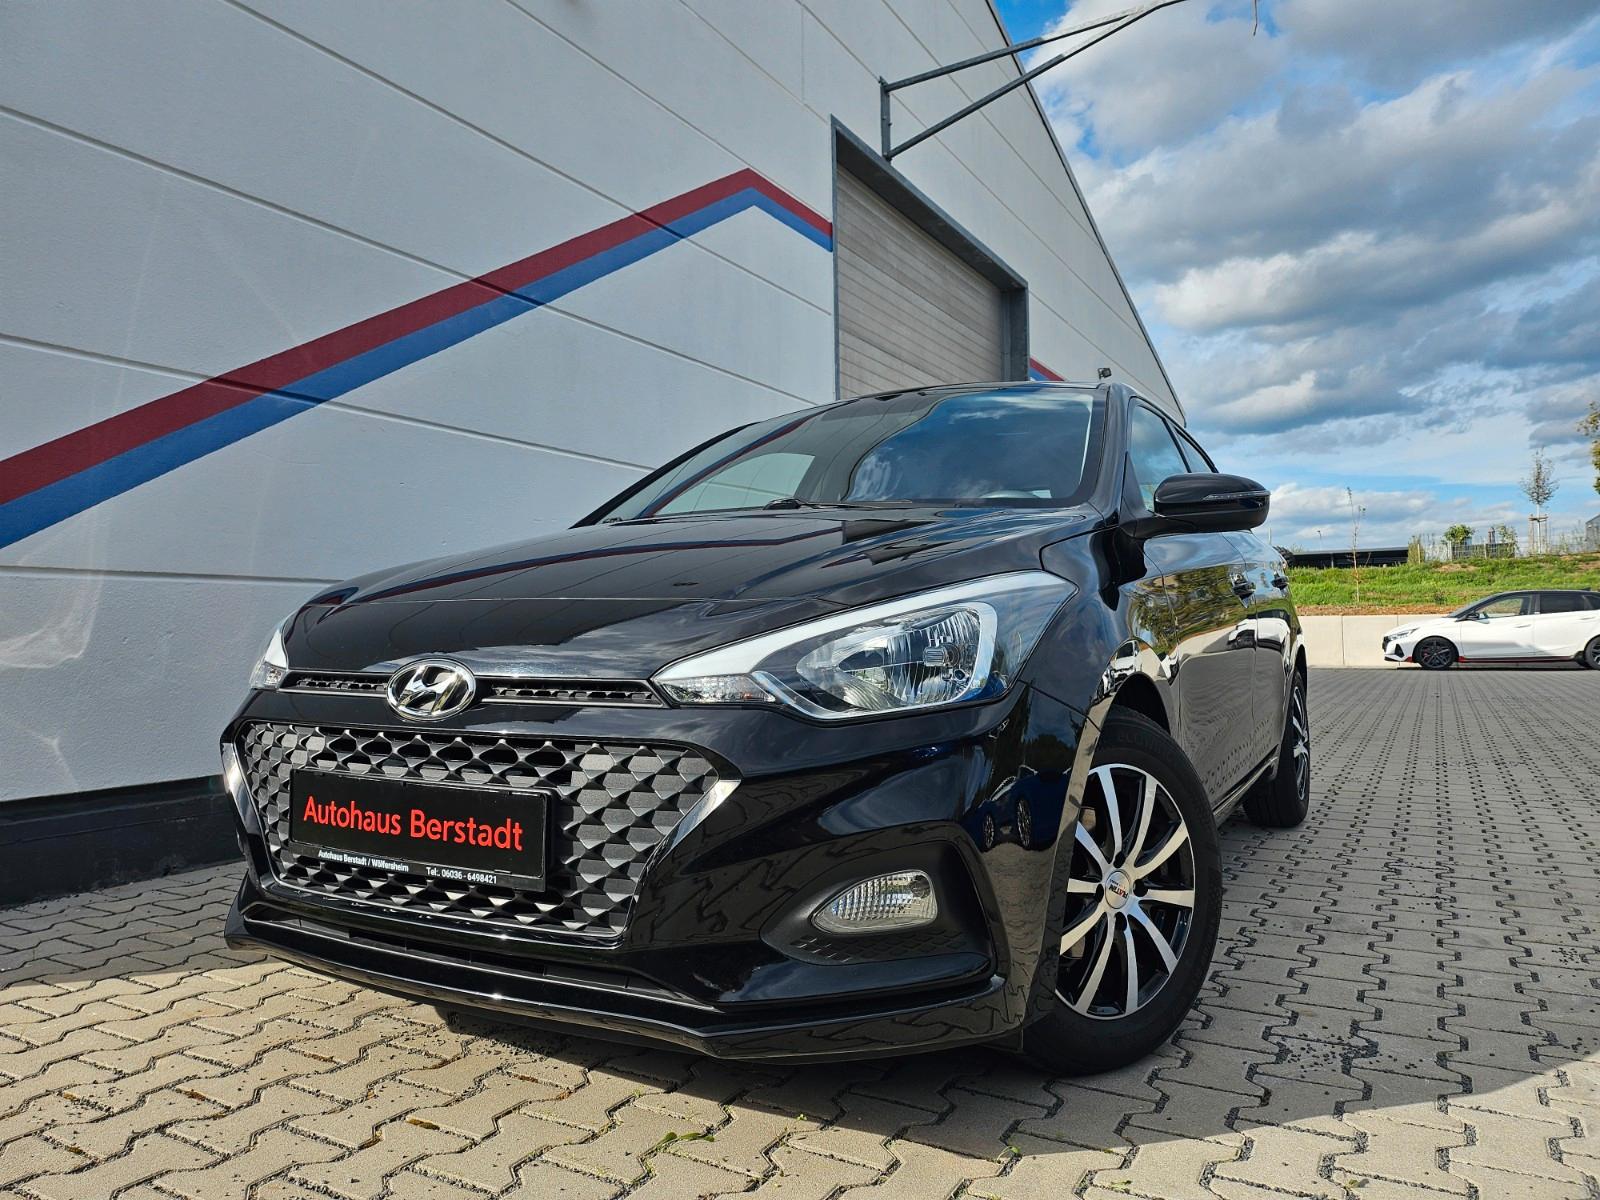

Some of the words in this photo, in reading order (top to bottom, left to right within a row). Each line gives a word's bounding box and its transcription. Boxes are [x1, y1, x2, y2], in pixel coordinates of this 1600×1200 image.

[303, 796, 401, 836] Autohaus
[410, 809, 524, 851] Berstadt
[318, 850, 342, 861] Autohaus
[343, 854, 366, 866] Berstadt
[441, 869, 463, 880] 06036
[467, 872, 497, 884] 6498421
